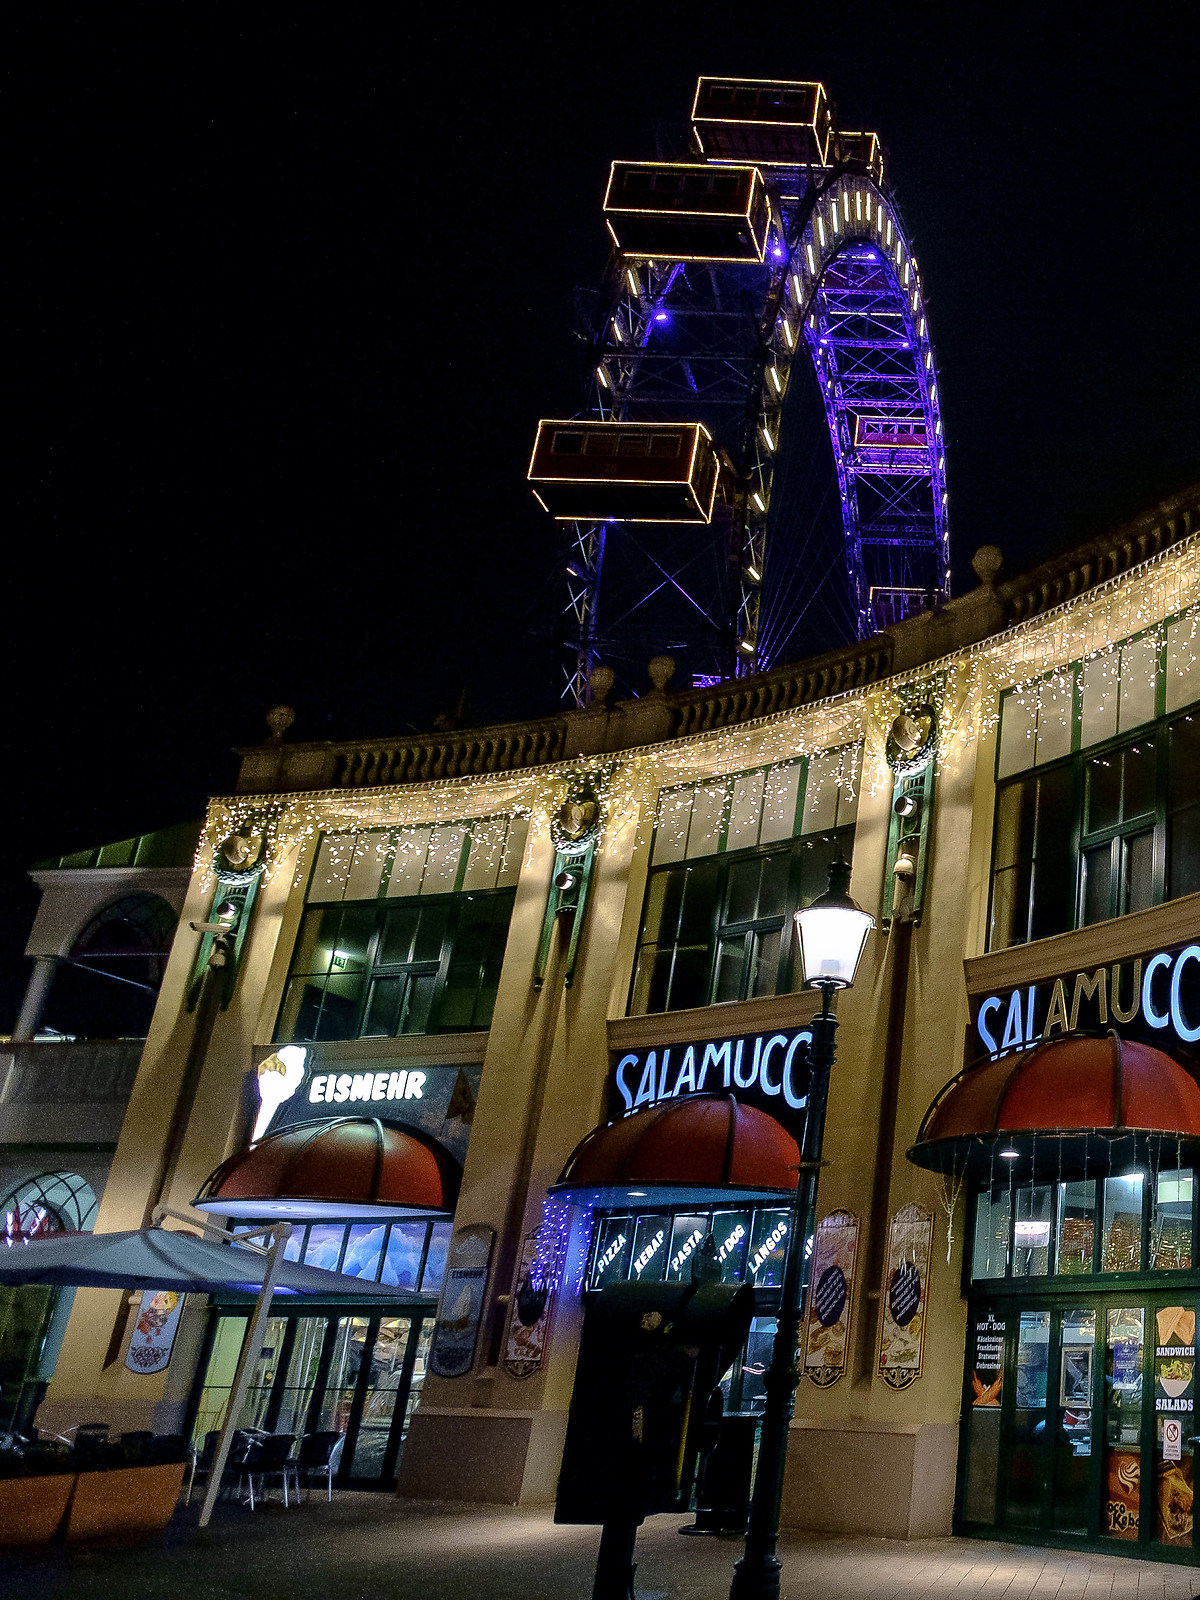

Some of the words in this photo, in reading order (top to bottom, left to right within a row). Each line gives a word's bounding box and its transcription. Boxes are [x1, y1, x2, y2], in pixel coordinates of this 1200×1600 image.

[308, 1069, 427, 1104] EISMEHR
[612, 1031, 813, 1118] SALAMUCC
[597, 1233, 627, 1273] PIZZA
[633, 1230, 664, 1274] KEBAP
[671, 1229, 704, 1272] PASTA
[748, 1221, 788, 1274] LANGOS
[993, 1322, 1005, 1330] DOG
[1156, 1347, 1195, 1357] SANDWICH
[1155, 1398, 1194, 1411] SALADS
